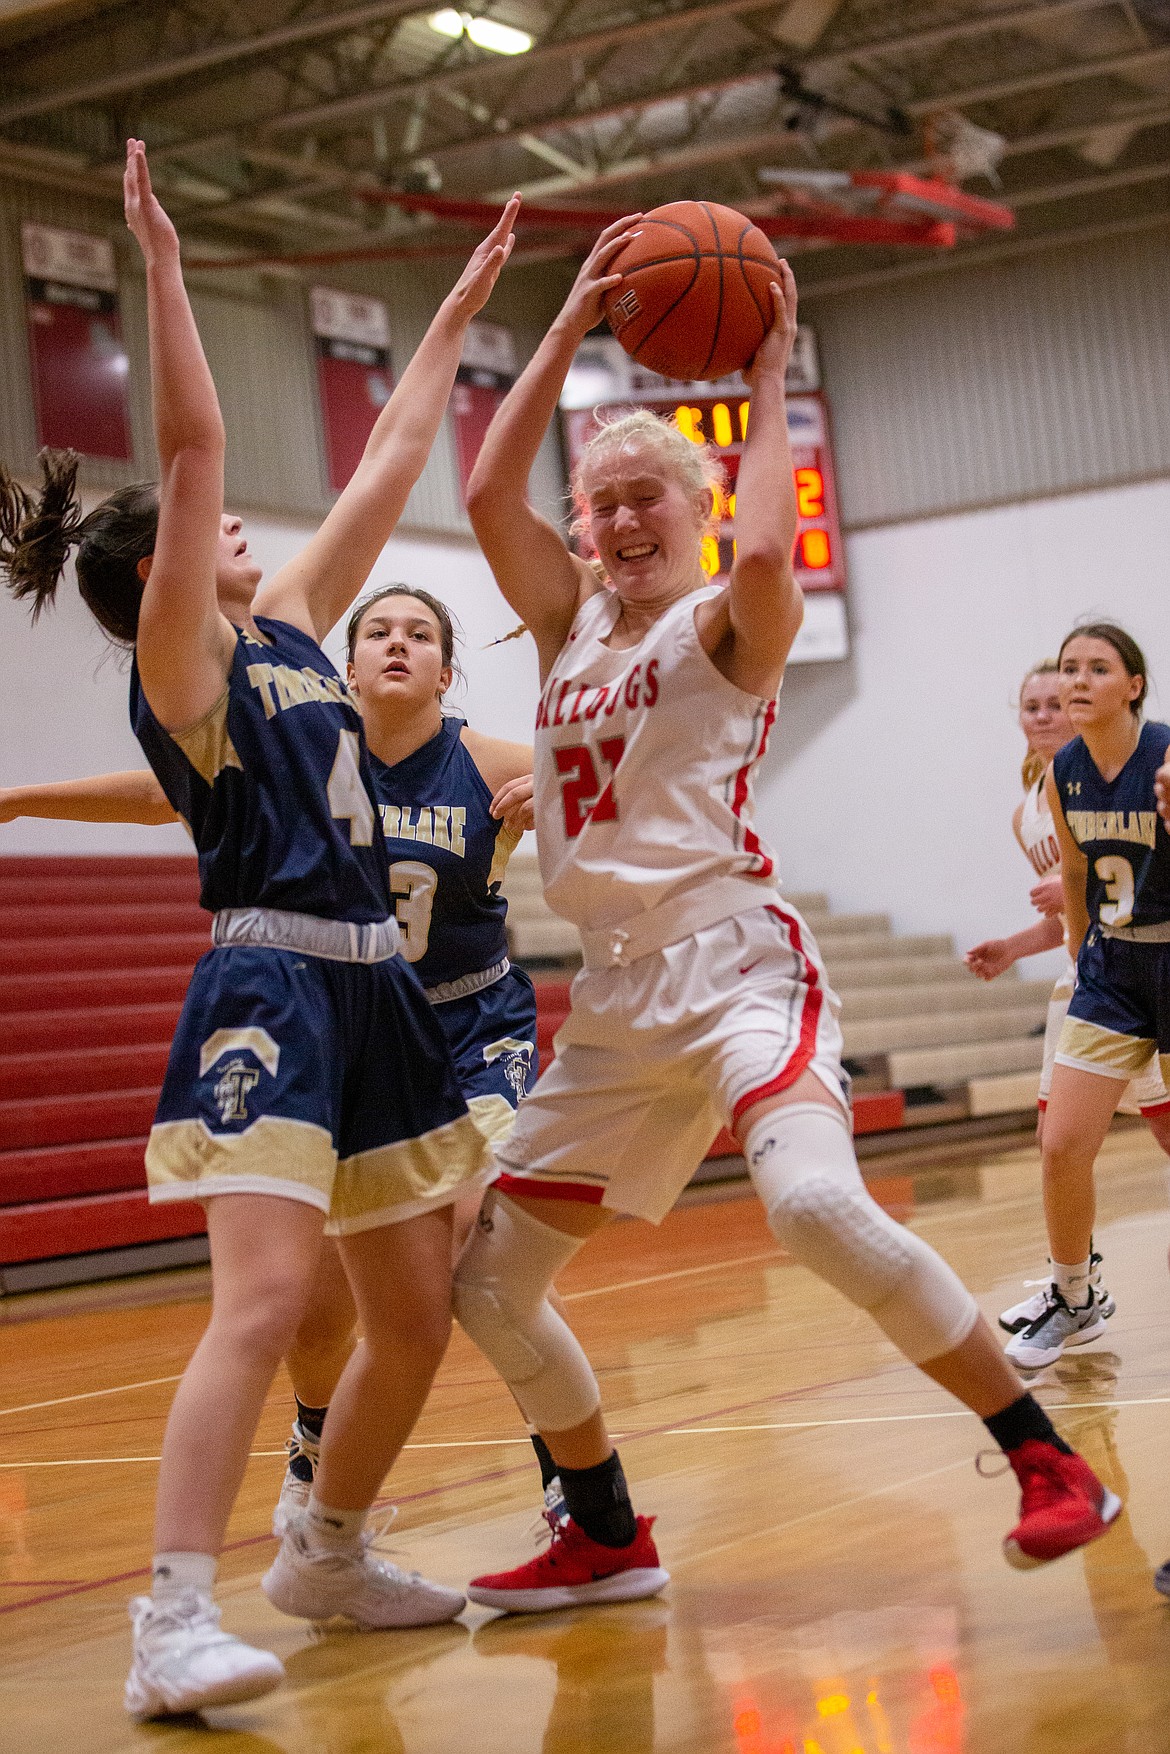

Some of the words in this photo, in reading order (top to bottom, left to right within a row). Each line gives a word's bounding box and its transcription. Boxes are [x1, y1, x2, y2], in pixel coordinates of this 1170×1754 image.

[796, 468, 825, 518] 2
[327, 728, 376, 847] 4
[552, 735, 626, 839] 21
[1094, 855, 1135, 928] 3
